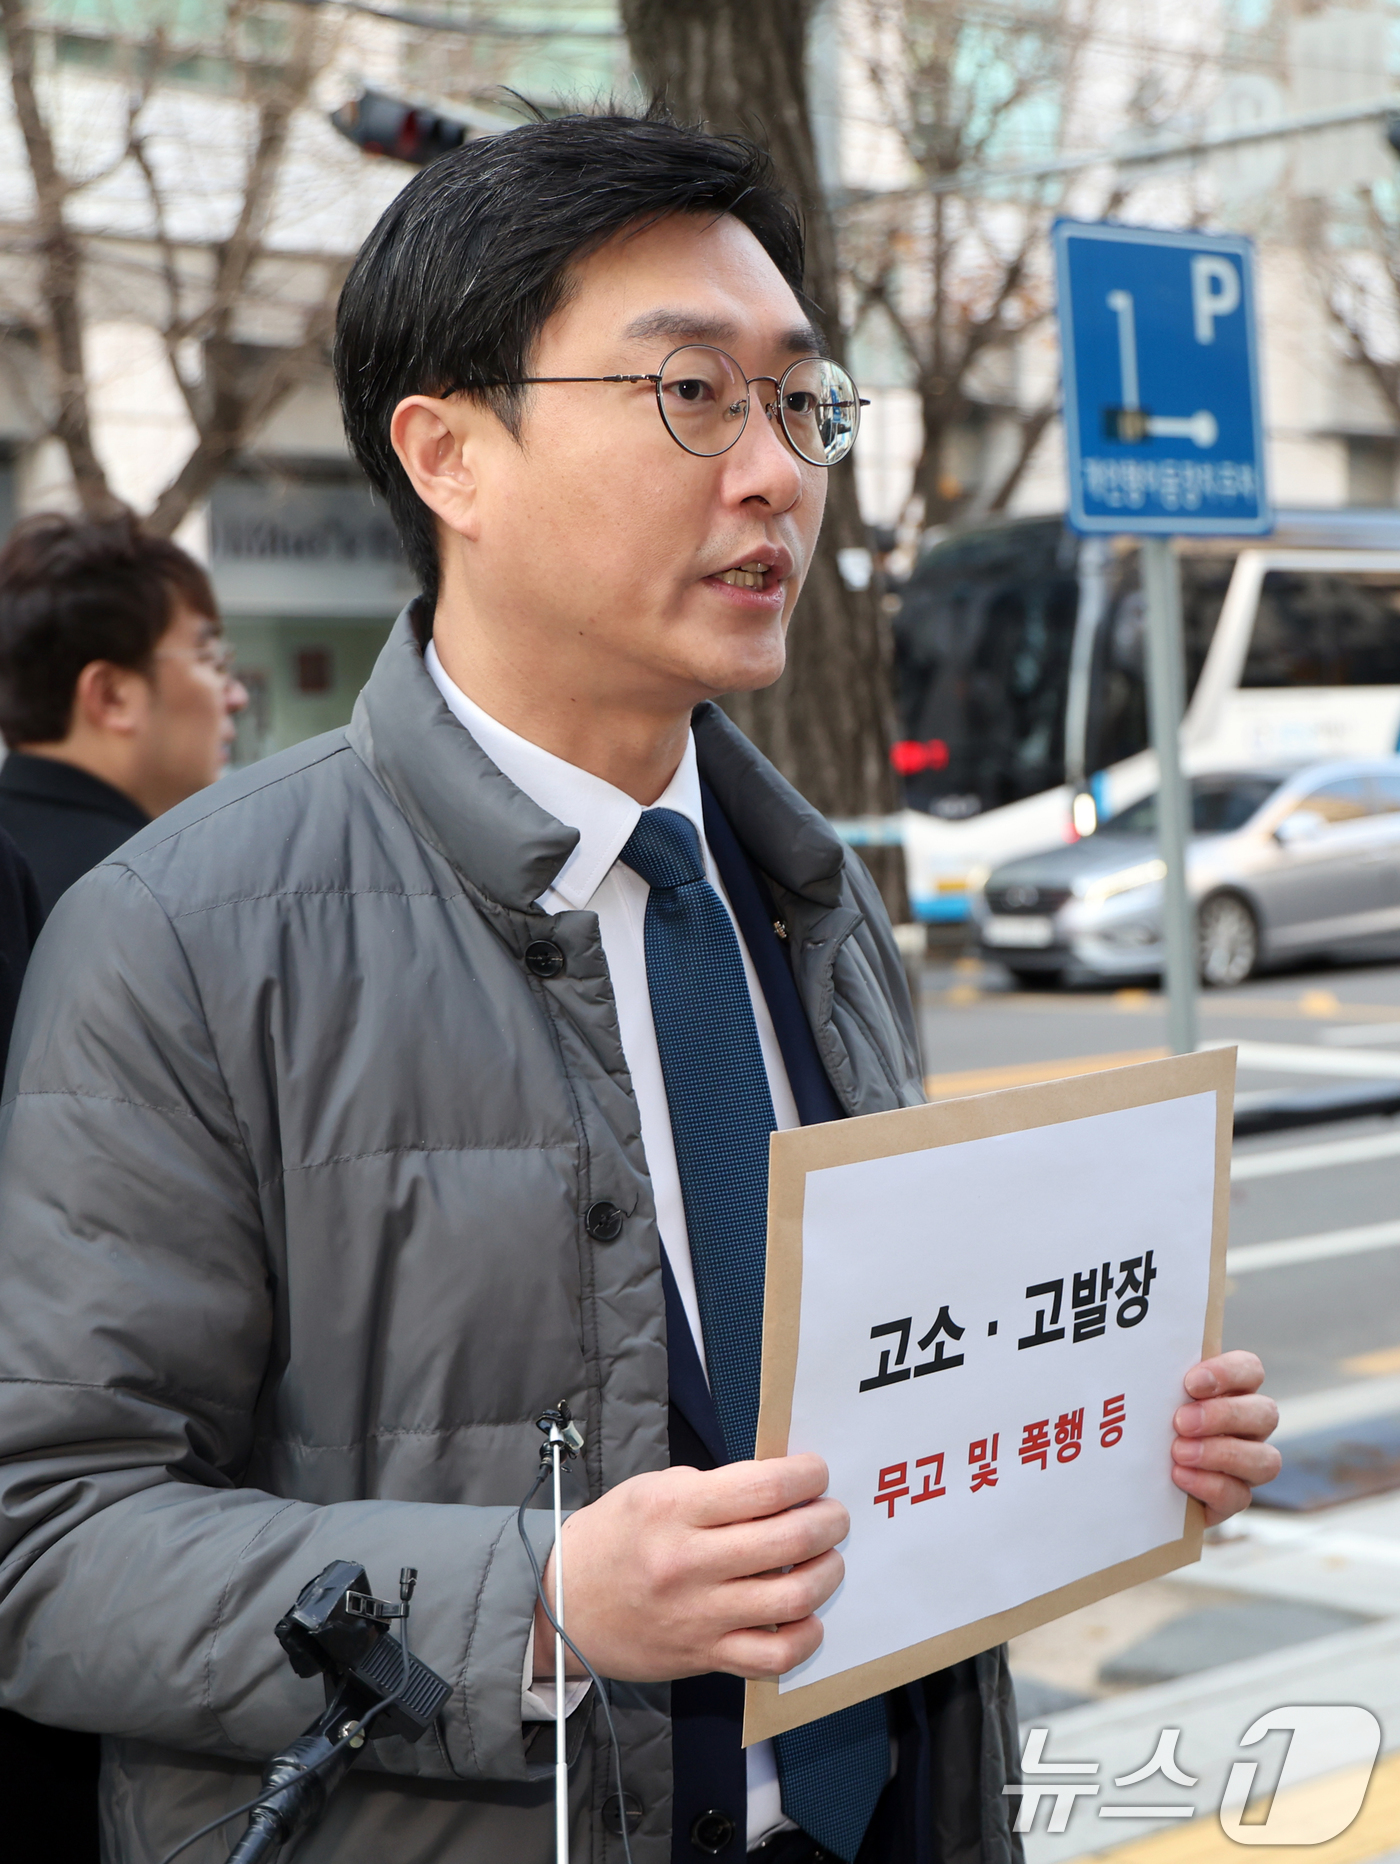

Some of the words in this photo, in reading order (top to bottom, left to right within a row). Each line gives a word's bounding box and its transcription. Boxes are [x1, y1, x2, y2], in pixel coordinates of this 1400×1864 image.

[1191, 253, 1242, 345] P
[859, 1305, 966, 1393] 고소
[1017, 1249, 1157, 1351] 고발장
[873, 1451, 946, 1519] 무고
[968, 1432, 1000, 1493] 및
[1018, 1407, 1085, 1471] 폭행
[1099, 1393, 1126, 1448] 등
